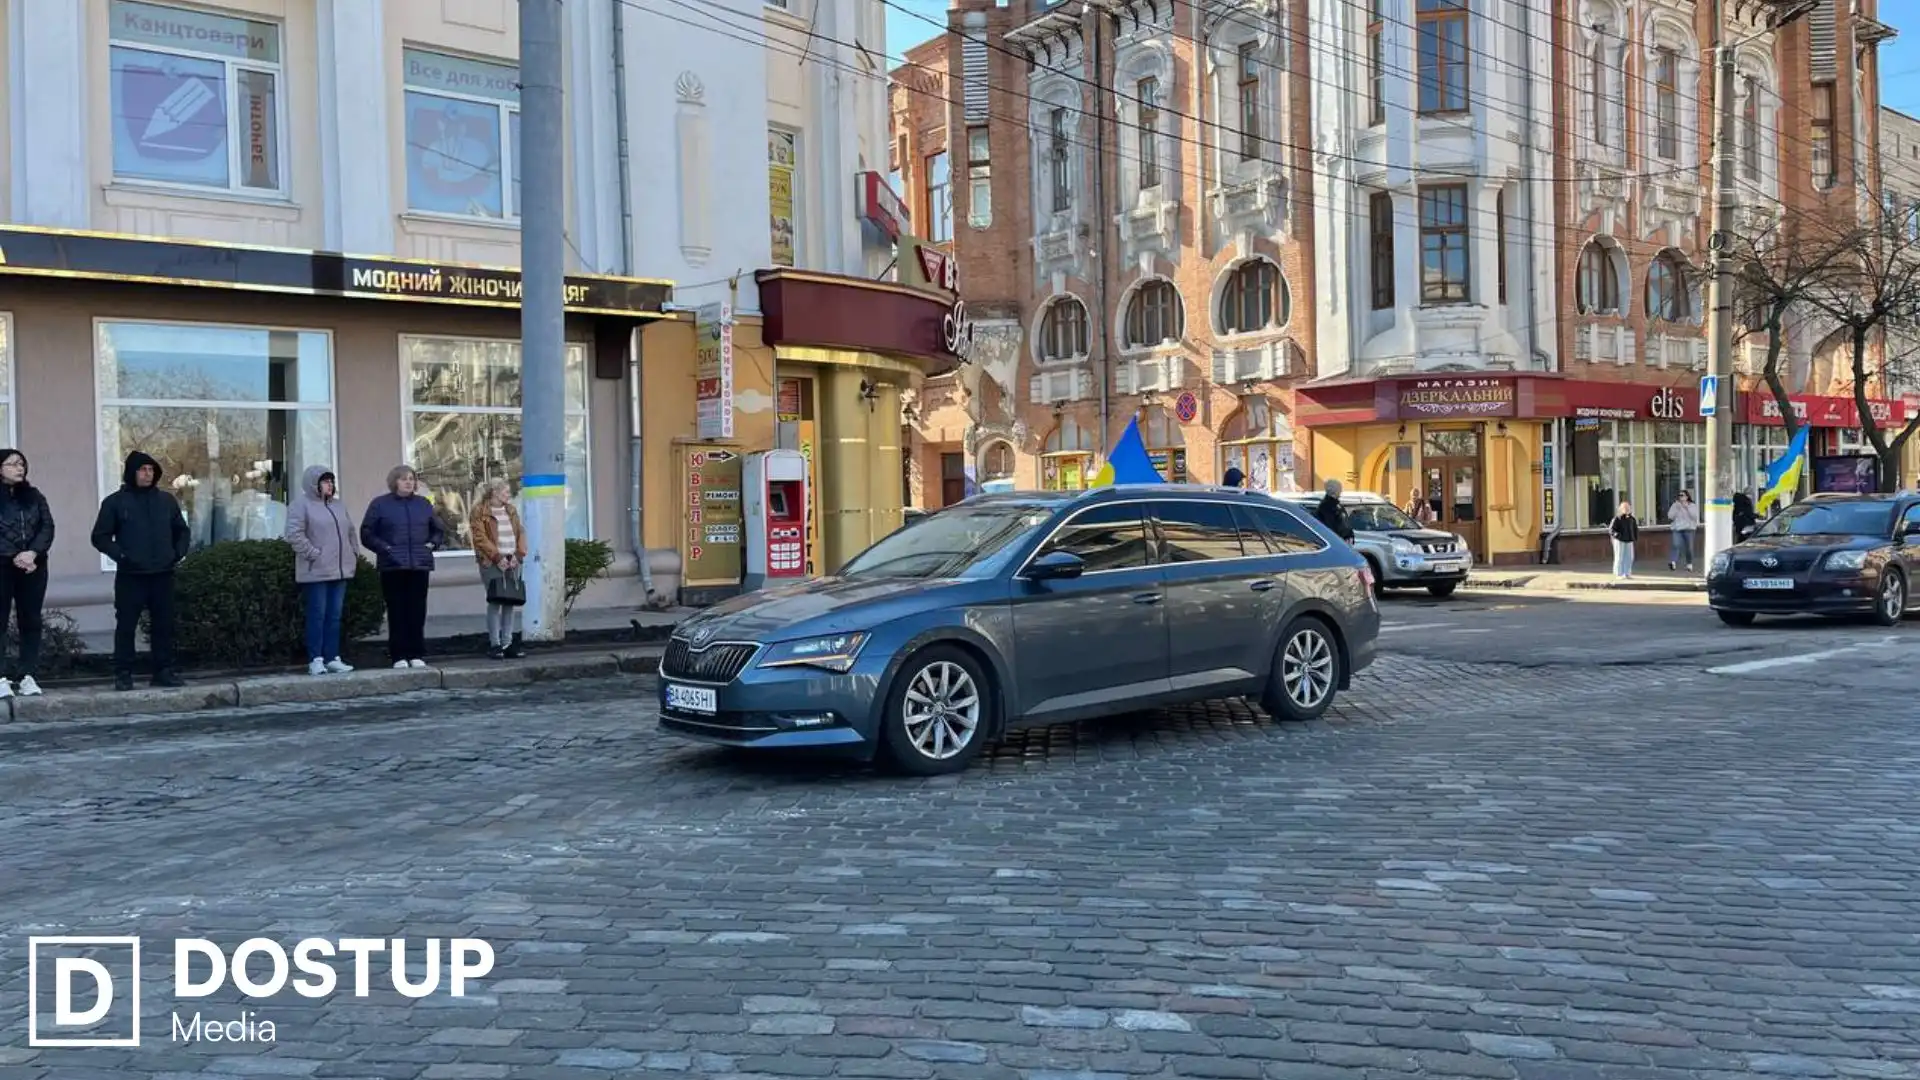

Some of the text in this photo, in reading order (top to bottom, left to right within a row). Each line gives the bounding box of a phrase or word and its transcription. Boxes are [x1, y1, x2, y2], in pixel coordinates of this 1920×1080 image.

[124, 12, 265, 49] Канцтовари
[410, 60, 443, 79] Все
[446, 70, 480, 86] для
[352, 268, 442, 293] МОДНИЙ
[1400, 386, 1514, 405] ДЗЕРКАЛЬНИЙ
[1417, 380, 1500, 388] МАГАЗИН
[1651, 386, 1684, 418] elis
[689, 452, 705, 560] ЮВЕЛІР
